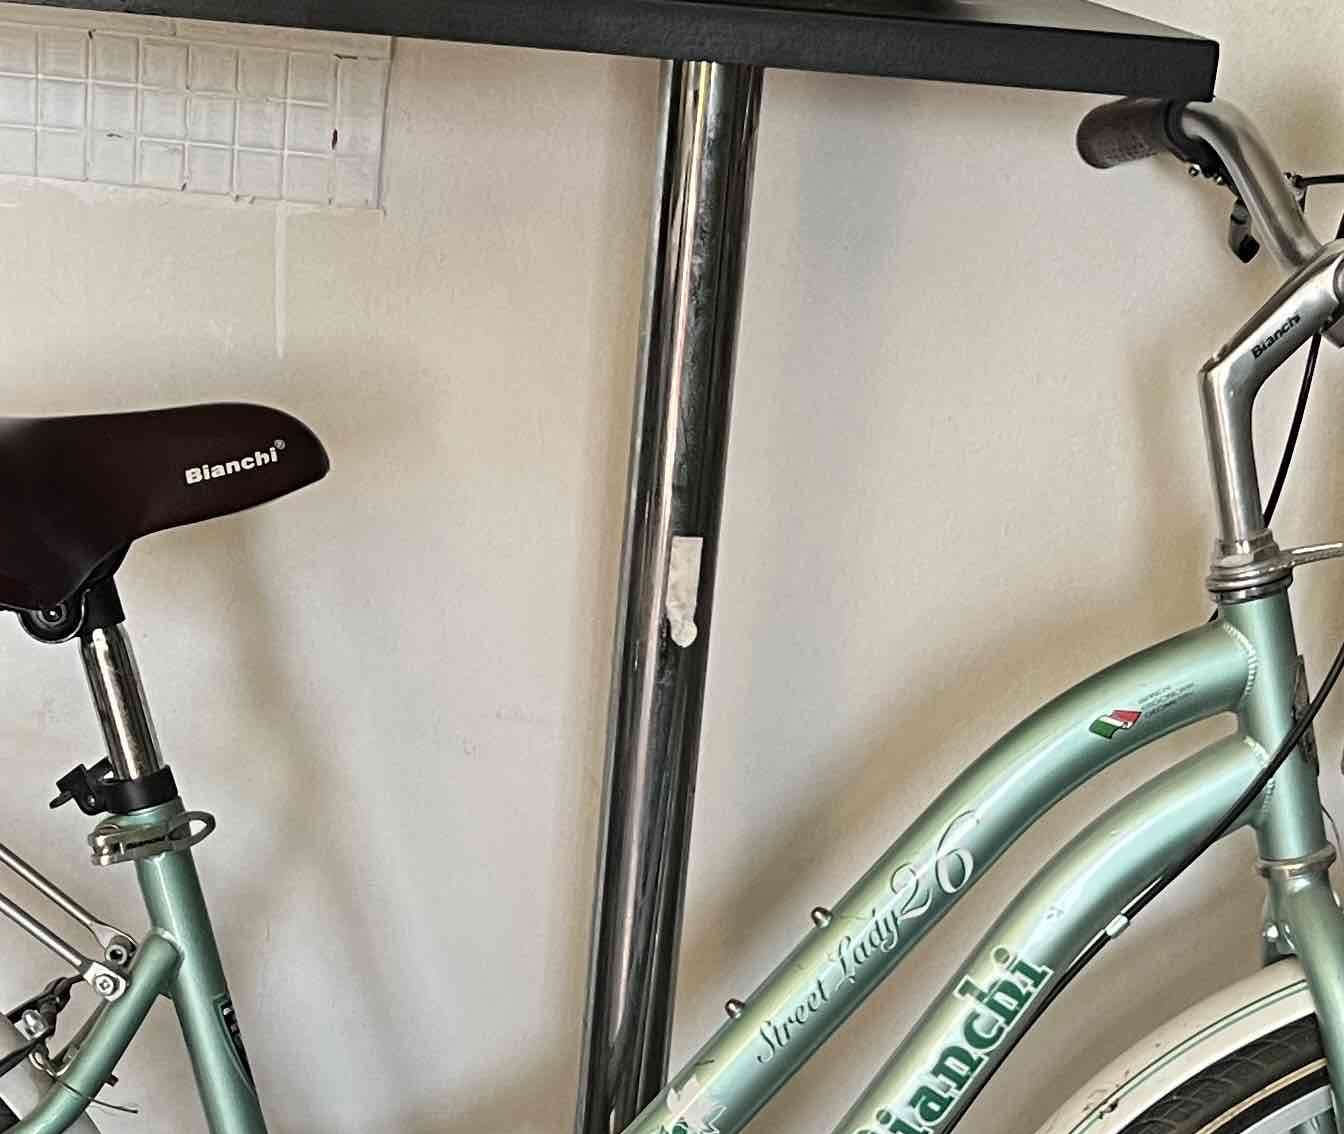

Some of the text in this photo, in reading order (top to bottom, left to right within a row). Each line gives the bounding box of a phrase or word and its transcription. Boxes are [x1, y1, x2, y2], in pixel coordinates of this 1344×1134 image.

[755, 808, 976, 1065] Street Lady 26
